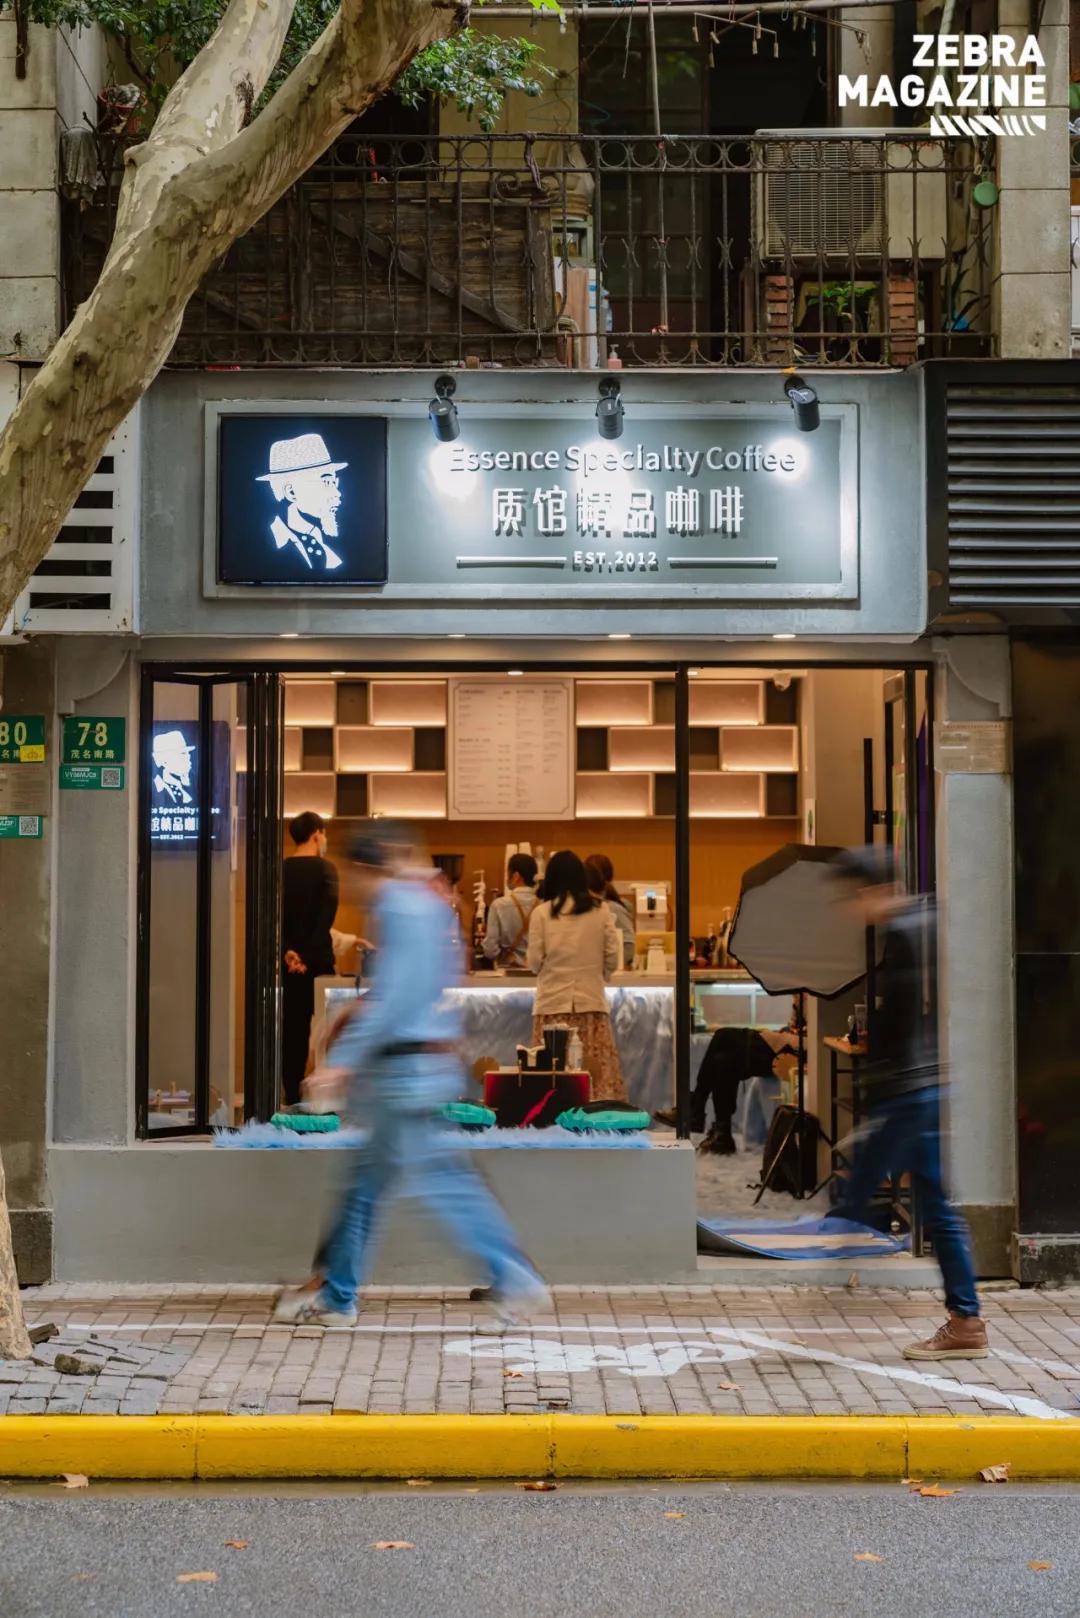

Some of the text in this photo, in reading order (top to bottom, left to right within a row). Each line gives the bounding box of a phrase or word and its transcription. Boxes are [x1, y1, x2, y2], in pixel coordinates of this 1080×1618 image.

[450, 444, 796, 477] Essence Specialty Coffee
[492, 485, 745, 535] 质馆精品咖啡
[573, 551, 657, 567] EST.2012
[0, 721, 26, 745] 80
[78, 722, 107, 746] 78
[71, 749, 114, 759] 茂名南路
[159, 806, 195, 815] Specialty
